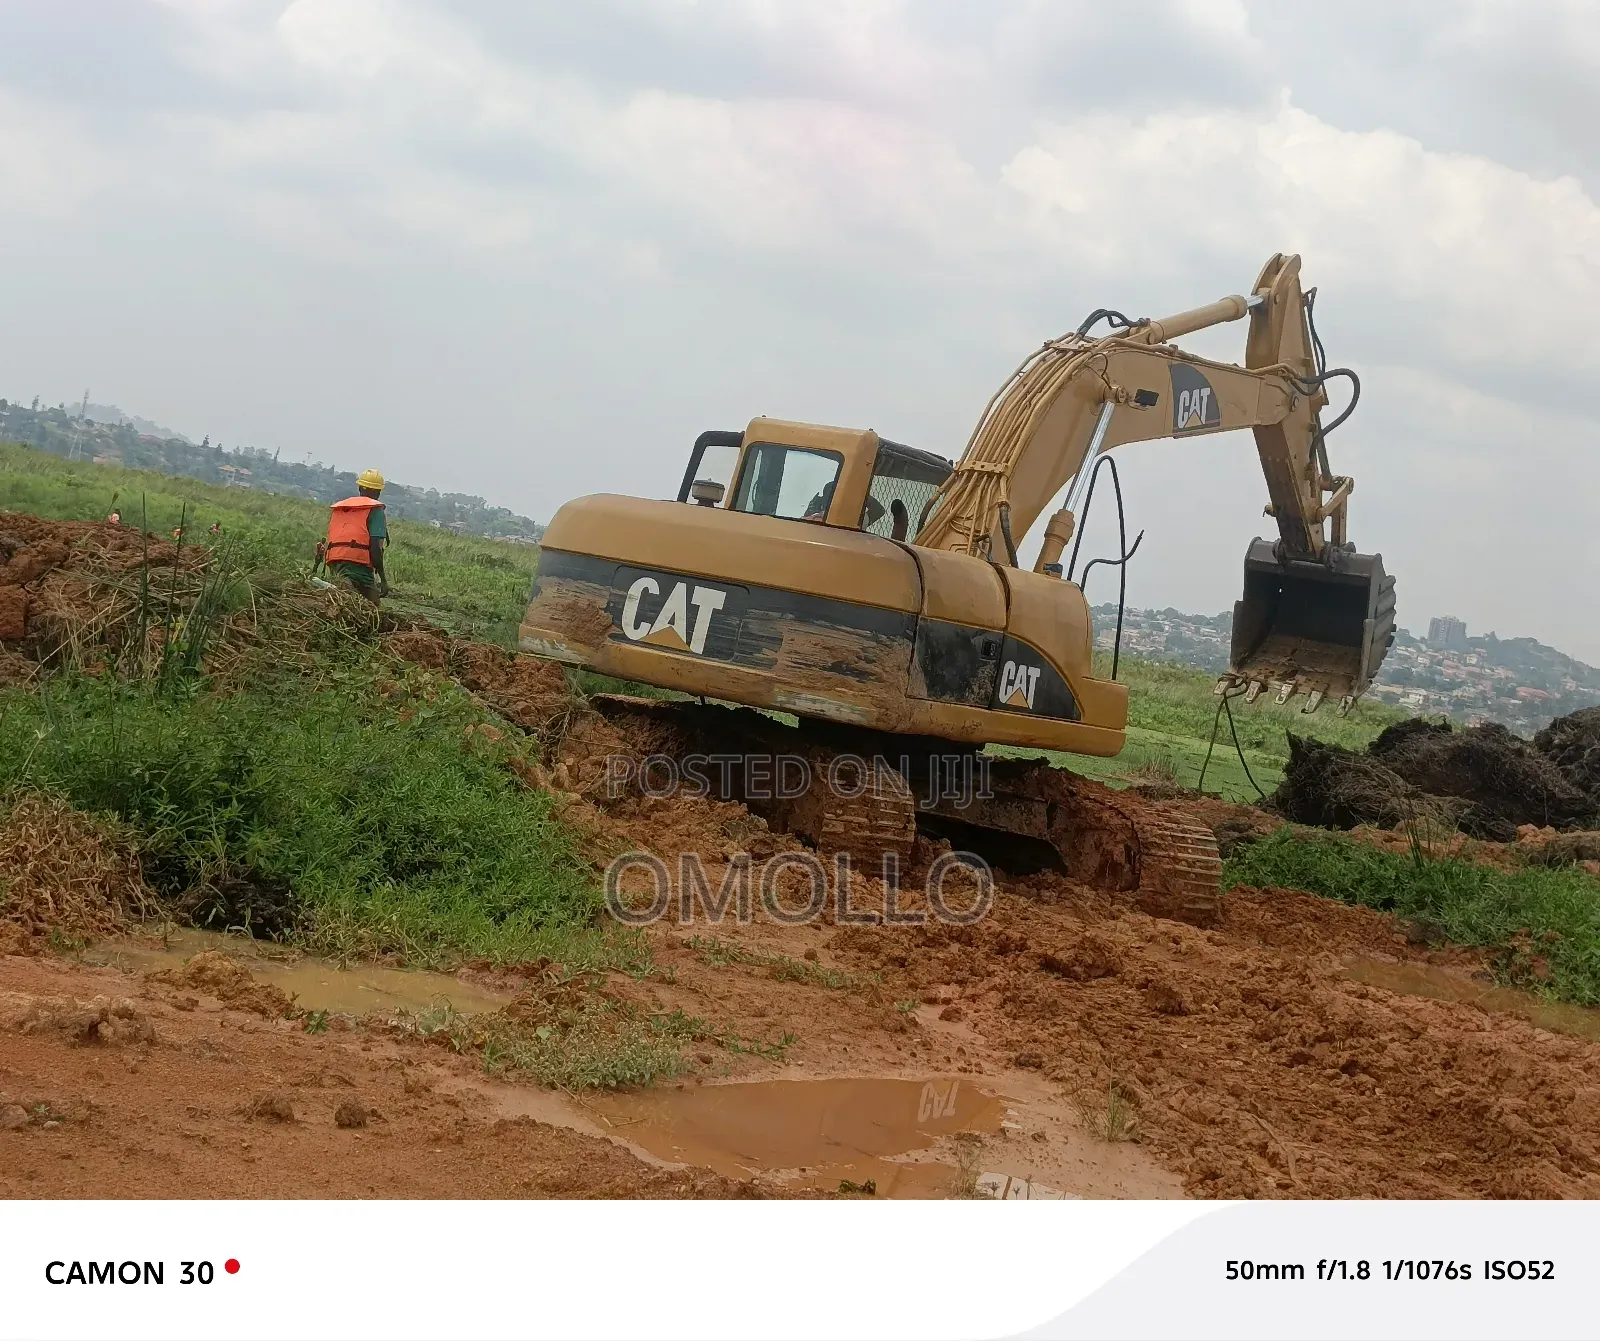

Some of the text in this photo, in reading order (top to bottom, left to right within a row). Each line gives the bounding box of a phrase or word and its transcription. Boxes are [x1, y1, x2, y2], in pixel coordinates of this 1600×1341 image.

[1177, 387, 1211, 429] CAT
[621, 576, 727, 655] CAT
[998, 660, 1041, 710] CAT
